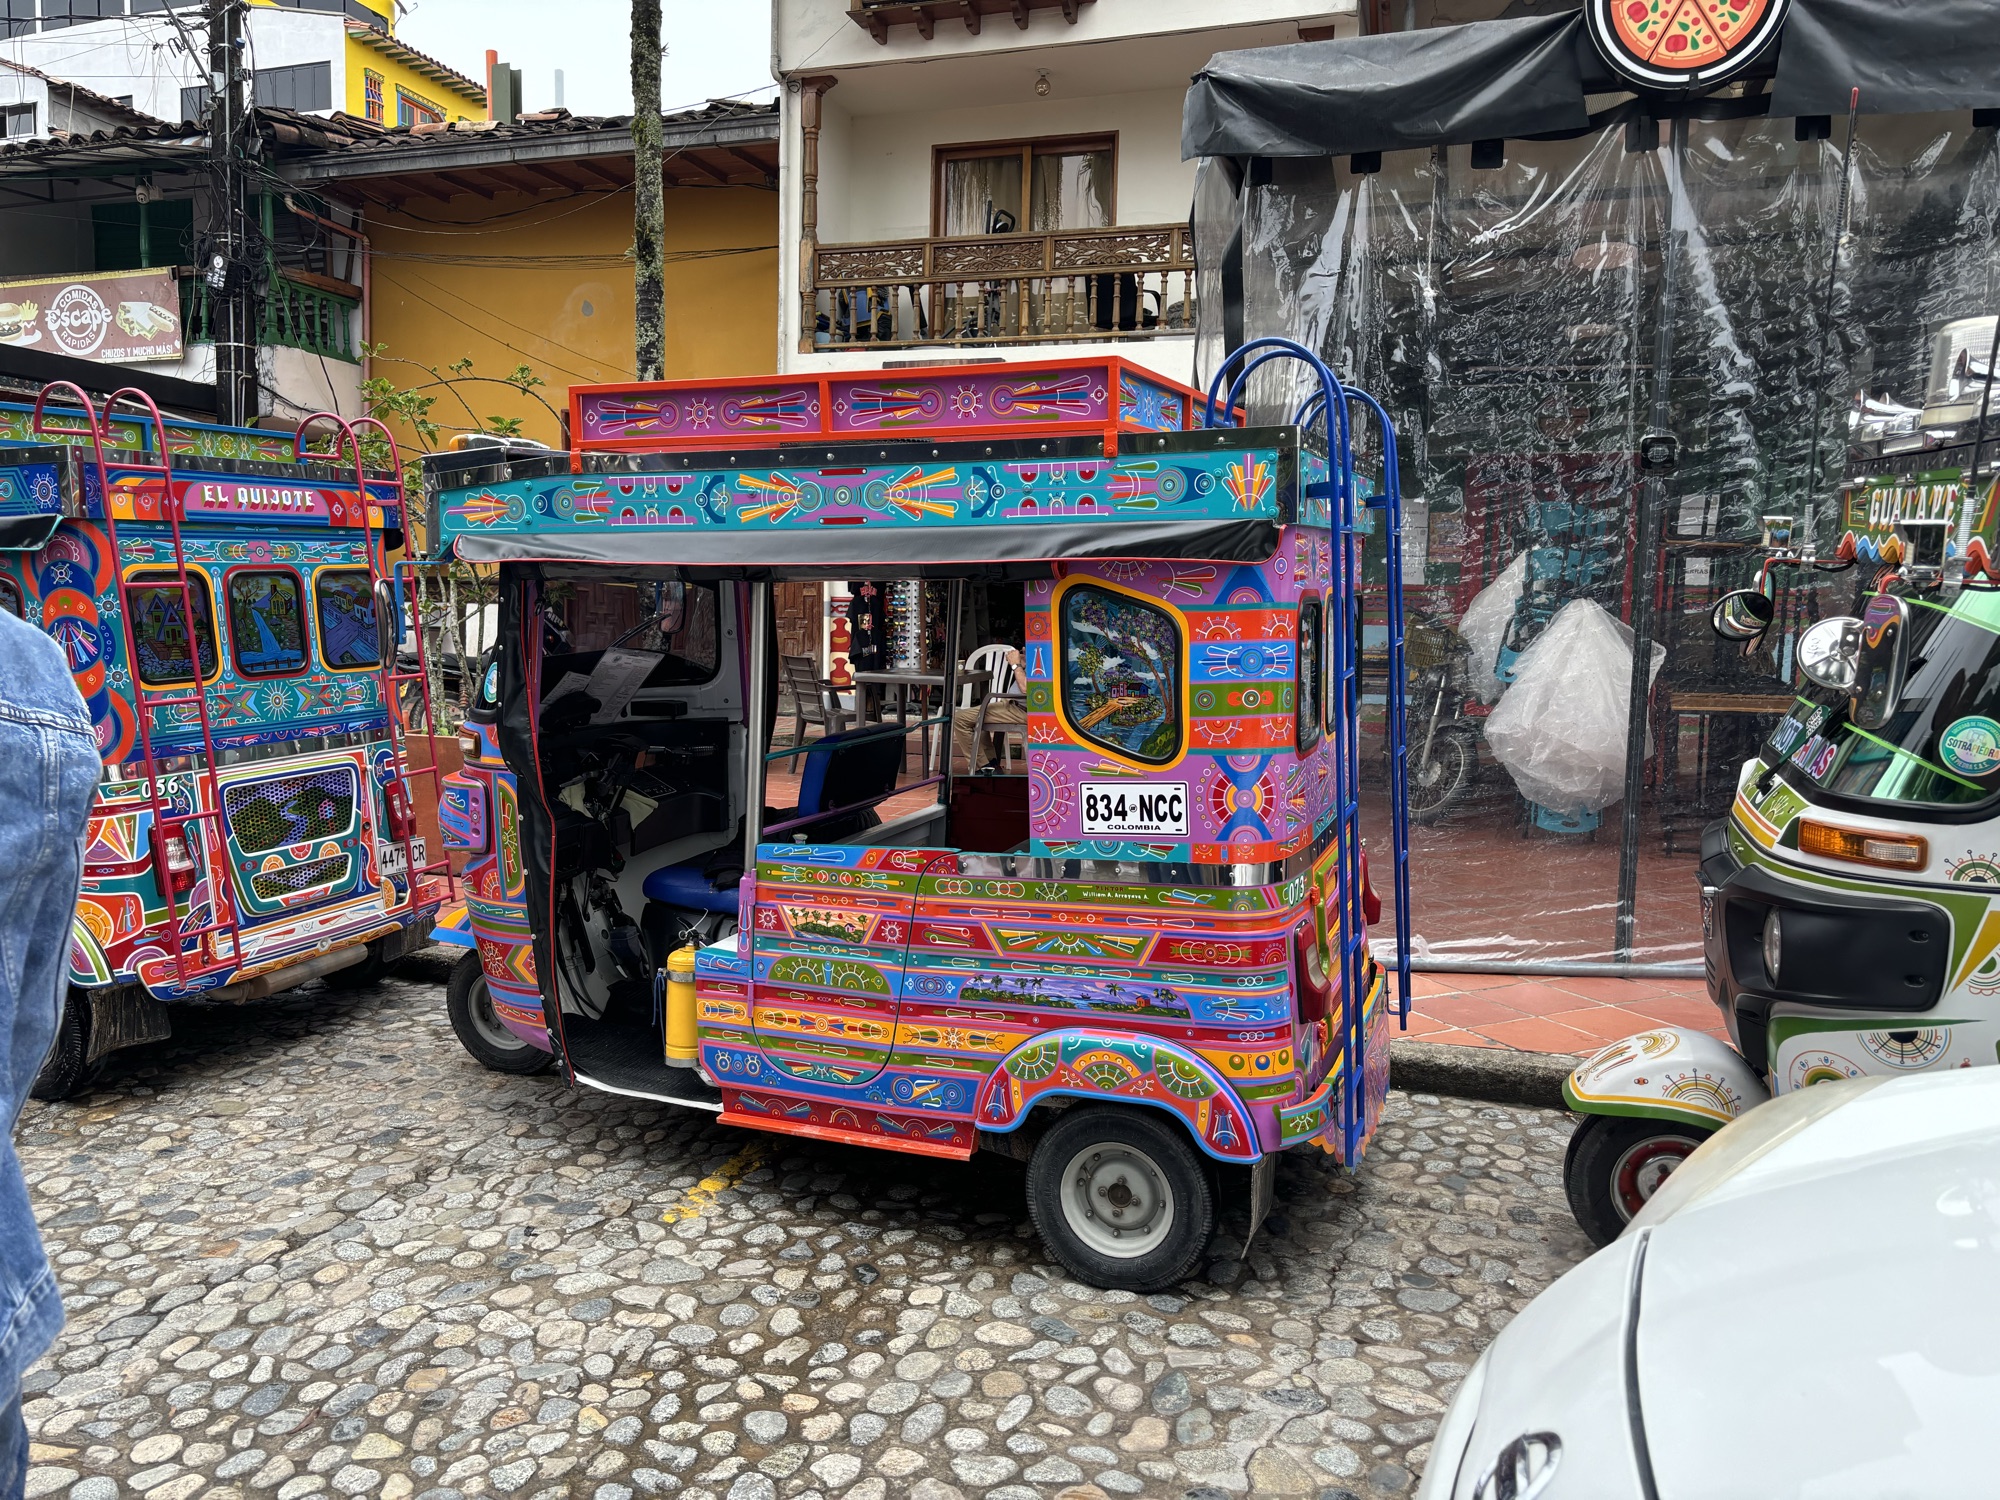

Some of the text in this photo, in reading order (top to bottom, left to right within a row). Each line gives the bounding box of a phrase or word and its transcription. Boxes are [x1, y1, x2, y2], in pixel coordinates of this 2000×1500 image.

[59, 290, 99, 310] COMIDAS
[45, 308, 113, 332] Escape
[60, 330, 96, 349] RAPIDAS
[101, 348, 125, 359] CHUZOS
[126, 347, 132, 357] Y
[133, 345, 155, 356] MUCHO
[202, 484, 316, 509] EL QUIJOTE
[1947, 737, 2000, 760] SOTRAPIEDRA
[141, 776, 179, 799] 056
[1086, 794, 1183, 823] 834 NCC
[382, 847, 401, 869] 447
[1288, 875, 1305, 906] 073
